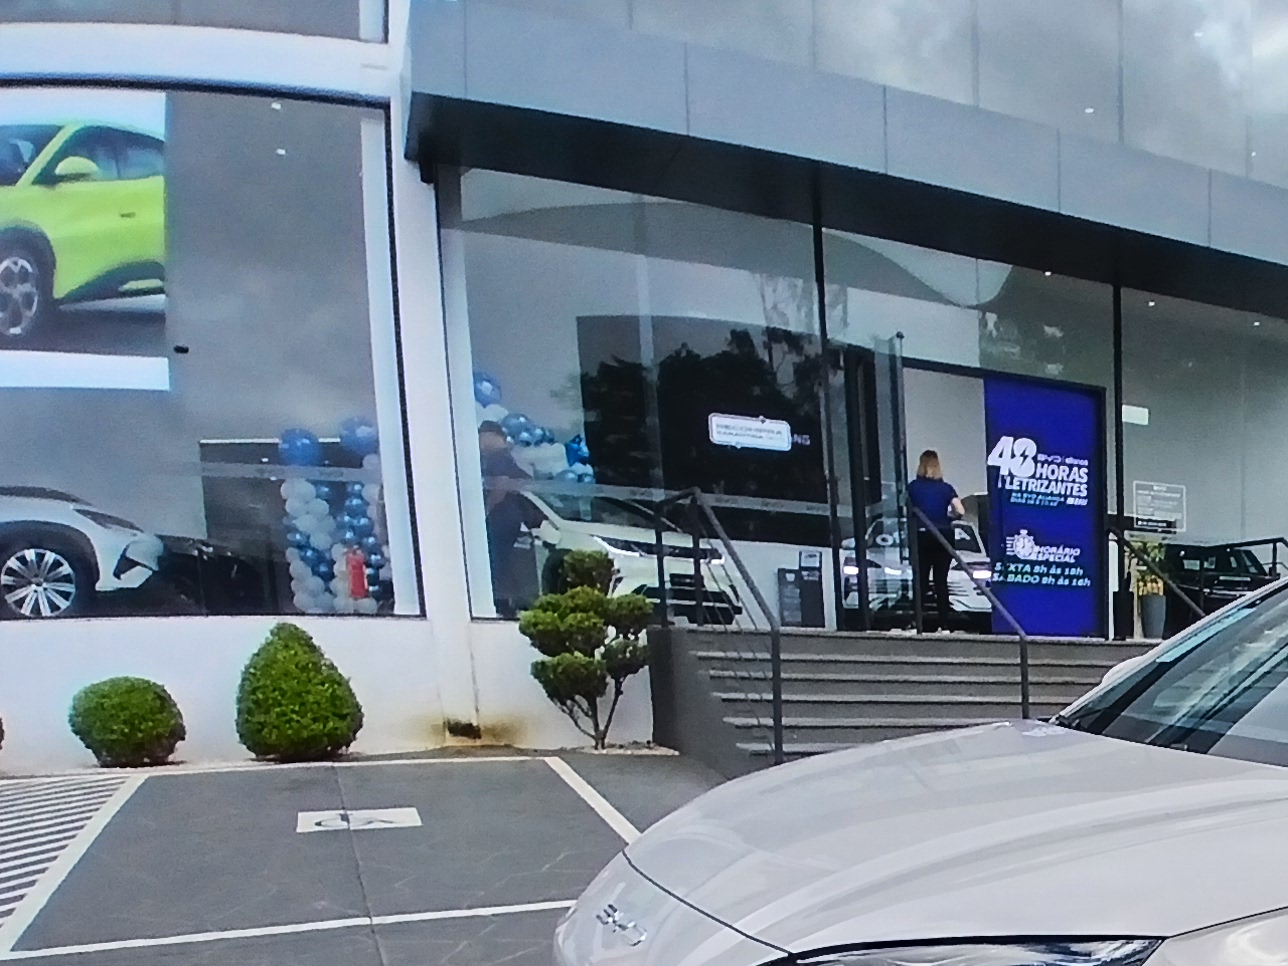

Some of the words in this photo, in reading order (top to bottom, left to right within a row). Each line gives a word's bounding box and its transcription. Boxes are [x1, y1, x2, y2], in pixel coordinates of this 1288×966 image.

[987, 436, 1037, 478] 48
[1036, 463, 1089, 483] HORAS
[994, 562, 1031, 573] SXTA
